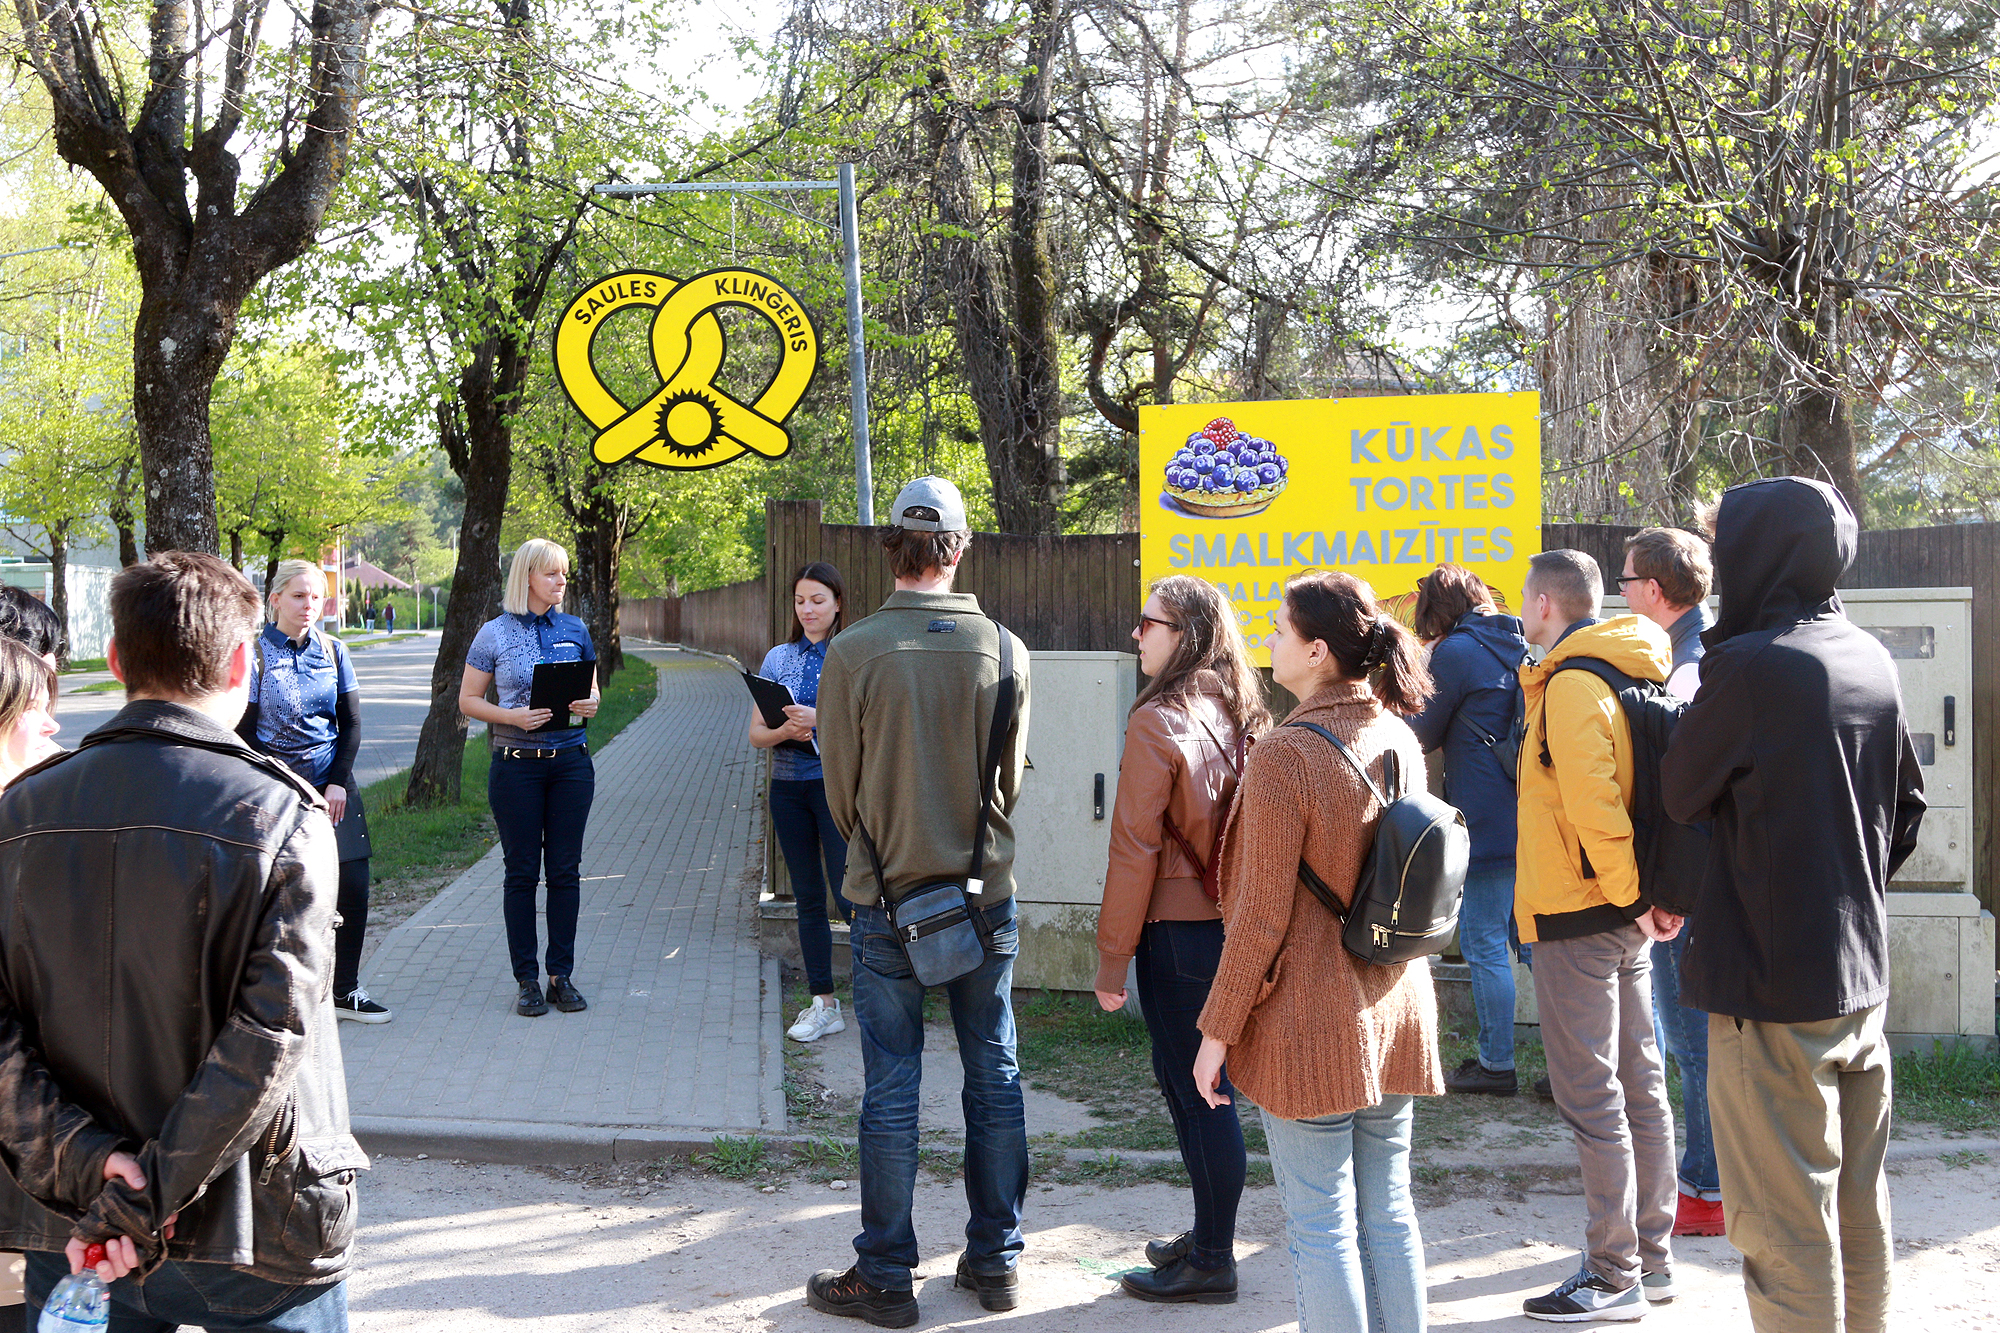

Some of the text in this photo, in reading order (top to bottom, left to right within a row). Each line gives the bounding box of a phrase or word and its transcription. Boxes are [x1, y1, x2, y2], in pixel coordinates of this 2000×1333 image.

[575, 280, 658, 325] SAULES
[1350, 420, 1515, 464] KŪKAS
[1349, 473, 1516, 512] TORTES
[1167, 520, 1515, 569] SMALKMAIZĪTES
